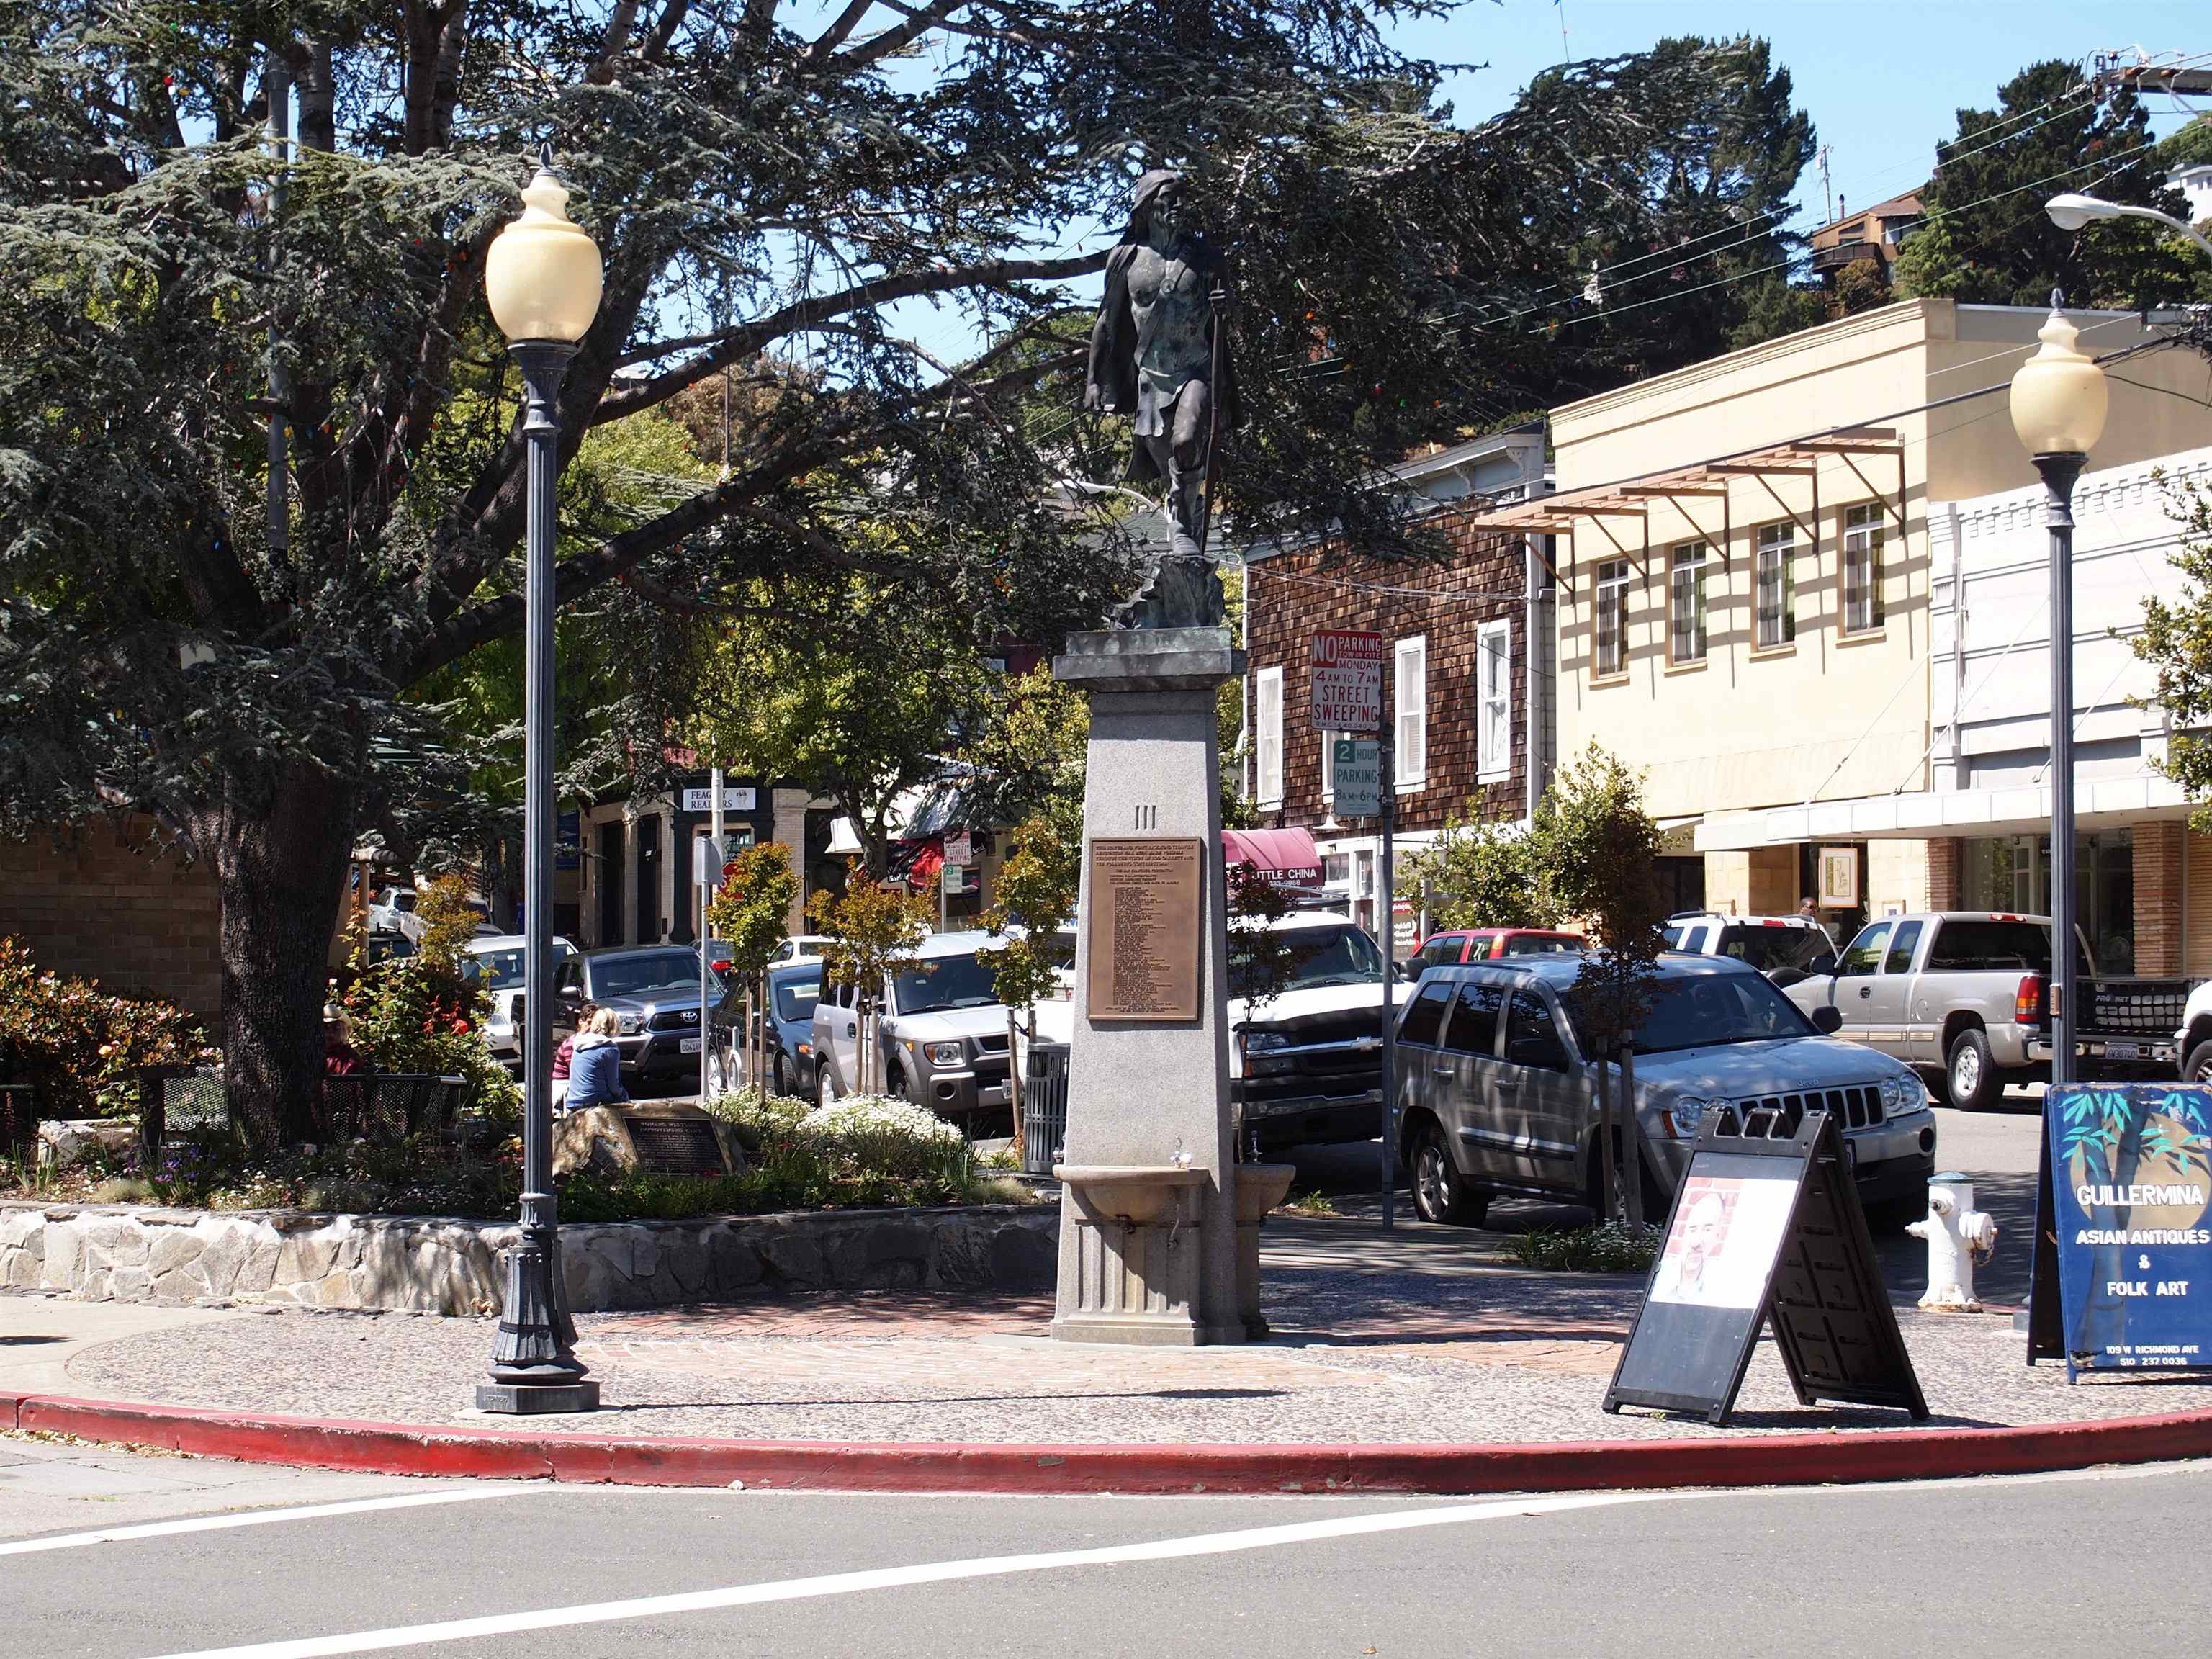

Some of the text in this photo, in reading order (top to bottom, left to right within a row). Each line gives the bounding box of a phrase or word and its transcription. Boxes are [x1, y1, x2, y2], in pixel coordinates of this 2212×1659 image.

[1313, 635, 1381, 662] NO PARKING
[1339, 660, 1378, 670] MONDAY
[1342, 674, 1354, 684] TO
[1322, 685, 1370, 703] STREET
[1314, 704, 1378, 722] SWEEPING
[1339, 744, 1377, 761] 2 HOUR
[1337, 769, 1377, 783] PARKING
[691, 791, 727, 799] FEAGY
[1287, 868, 1317, 879] CHINA
[1797, 1077, 1821, 1089] Jeep
[2077, 1184, 2205, 1206] GUILLERMINA
[2076, 1229, 2211, 1244] ASIAN ANTIQUES
[2138, 1254, 2151, 1269] &
[2107, 1281, 2189, 1296] FOLK ART
[2120, 1357, 2136, 1366] 510
